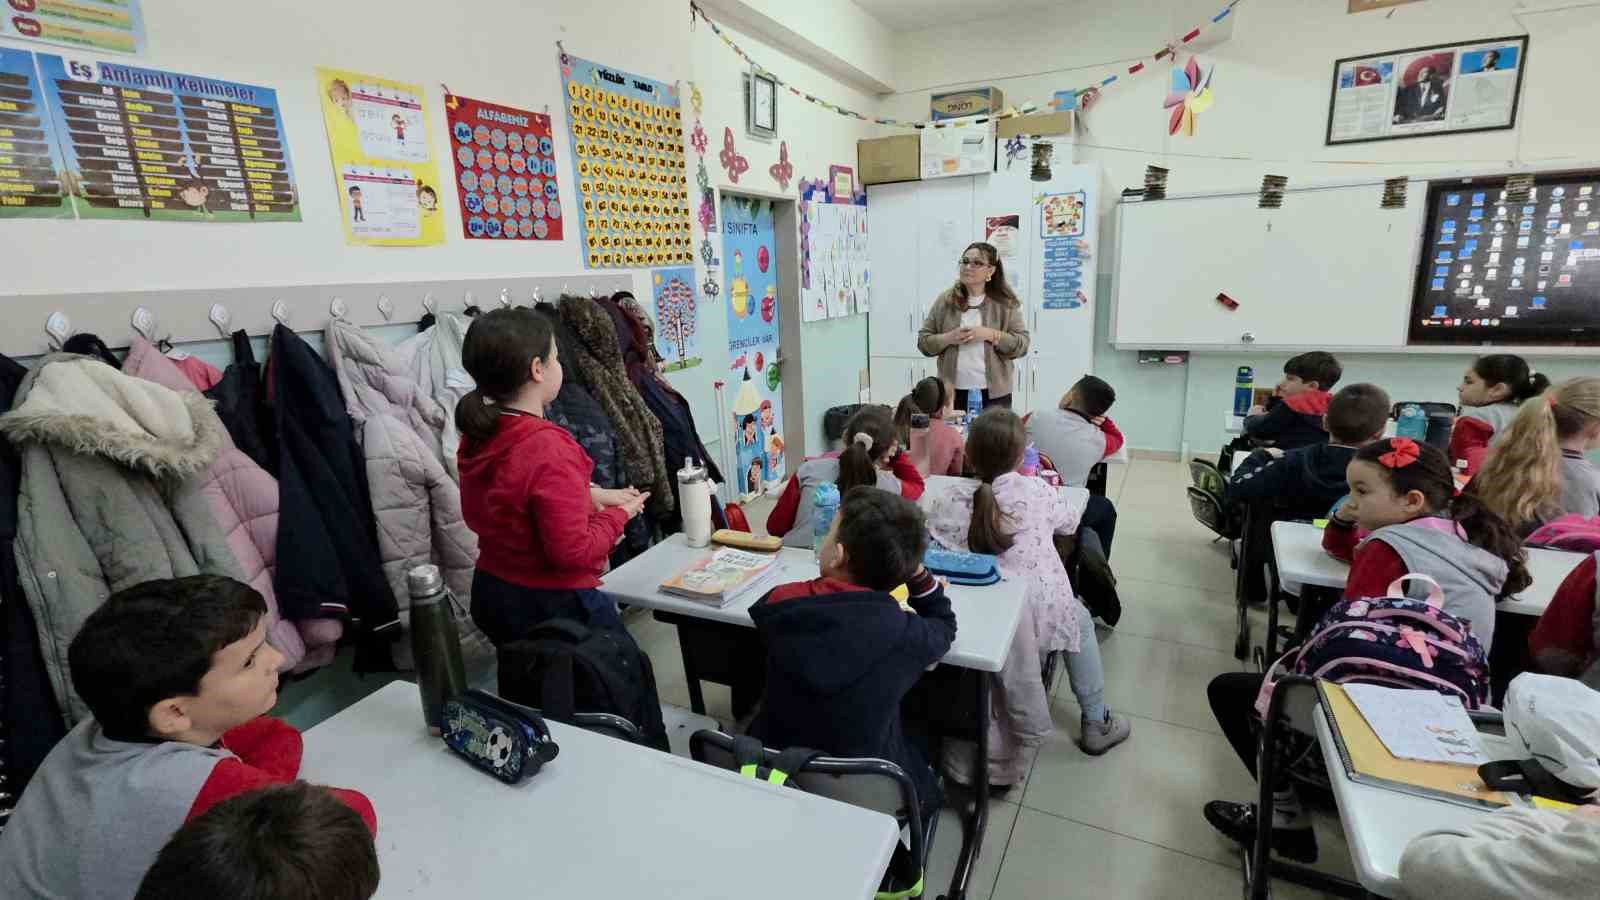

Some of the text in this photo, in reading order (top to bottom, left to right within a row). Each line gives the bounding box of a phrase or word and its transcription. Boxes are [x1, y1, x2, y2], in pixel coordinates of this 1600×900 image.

[70, 61, 256, 101] Eş Anlamlı Kelimeler
[727, 222, 759, 236] SINIFTA
